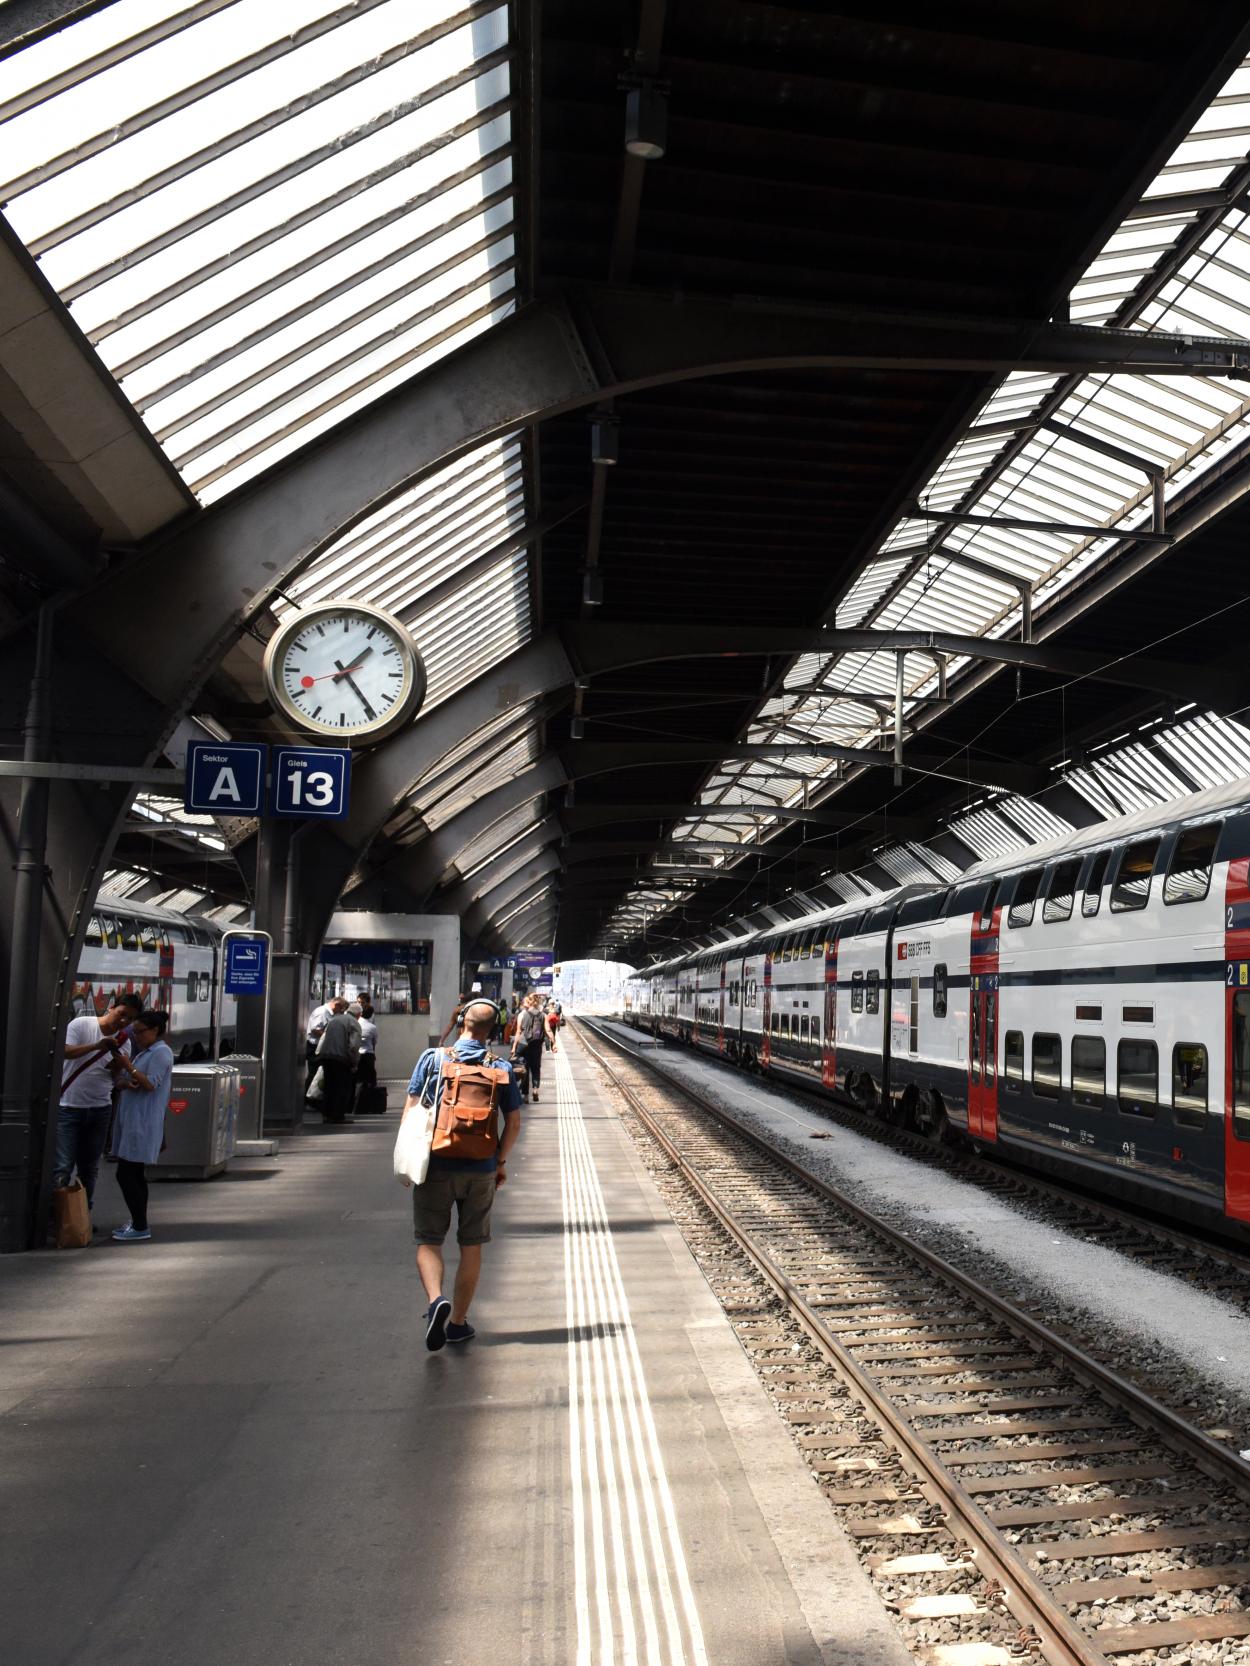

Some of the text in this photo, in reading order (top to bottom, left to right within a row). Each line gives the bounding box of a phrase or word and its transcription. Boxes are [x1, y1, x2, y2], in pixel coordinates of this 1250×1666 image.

[202, 754, 229, 763] Sektor
[287, 759, 308, 768] Gleis
[208, 766, 241, 802] A
[287, 770, 334, 807] 13
[1228, 906, 1234, 928] 2
[915, 942, 923, 956] CFF
[923, 941, 931, 955] FFS
[494, 959, 500, 967] A
[507, 960, 516, 968] 13
[1228, 964, 1234, 985] 2
